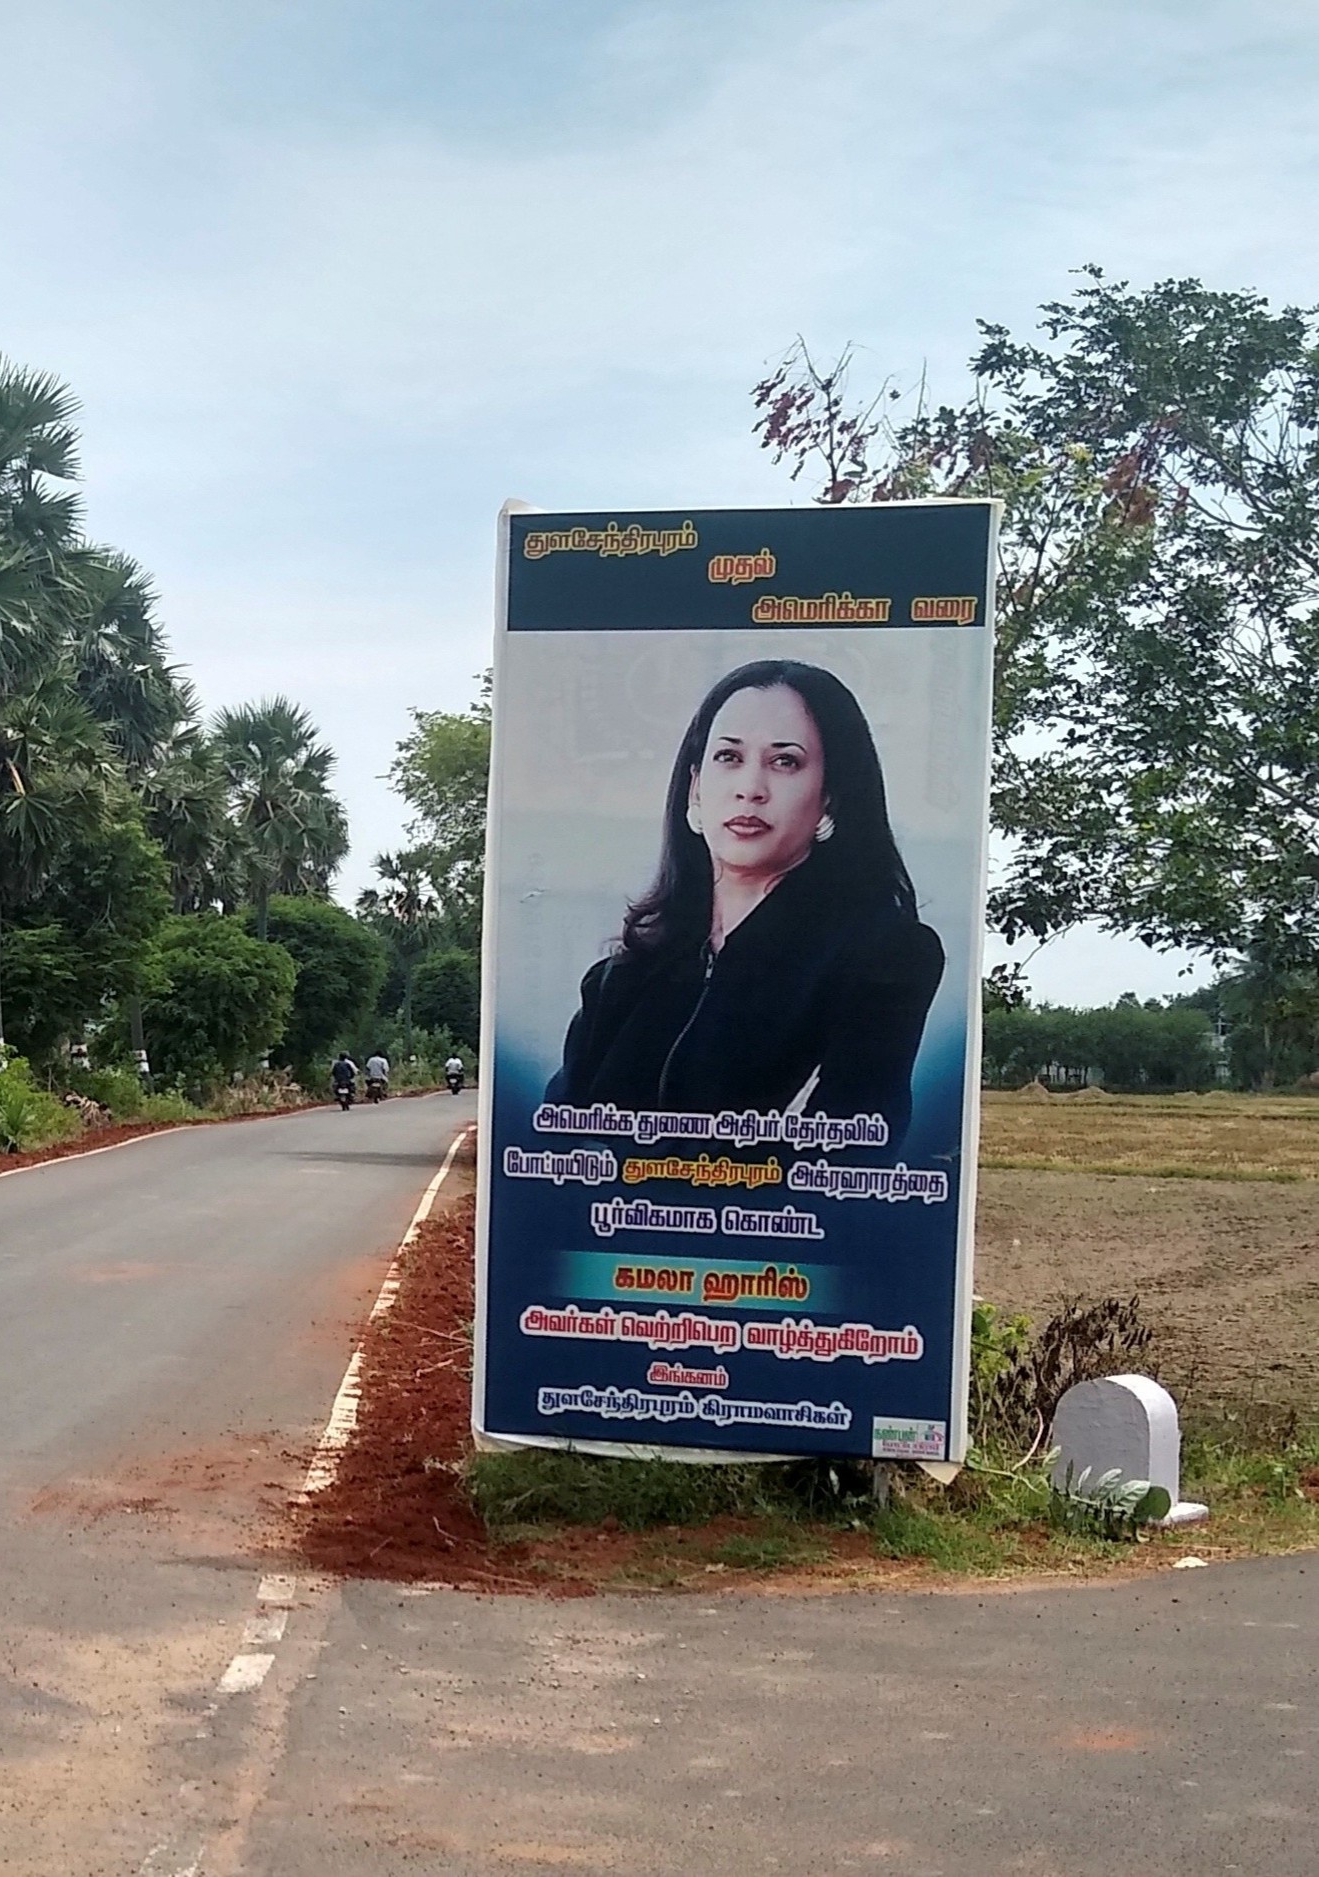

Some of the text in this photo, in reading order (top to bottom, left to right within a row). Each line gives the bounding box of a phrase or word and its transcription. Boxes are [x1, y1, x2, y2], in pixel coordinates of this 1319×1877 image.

[525, 521, 697, 558] துளசேந்திரபுரம்
[709, 549, 775, 584] முதல்
[753, 593, 977, 625] அமெரிக்கா வரை
[535, 1104, 888, 1150] அமெரிக்க துணை அதிபர் தேர்தலில்
[505, 1147, 948, 1203] போட்டியிடும் துளசேந்திரபுரம் அக்ரஹாரத்தை
[722, 1205, 825, 1239] கொண்ட
[614, 1264, 810, 1301] கமலா ஹாரிஸ்
[520, 1305, 923, 1364] அவர்கள் வெற்றிபெற வாழ்த்துகிறோம்
[538, 1387, 852, 1430] துளசேந்திரபுரம் கிராமவாசிகள்
